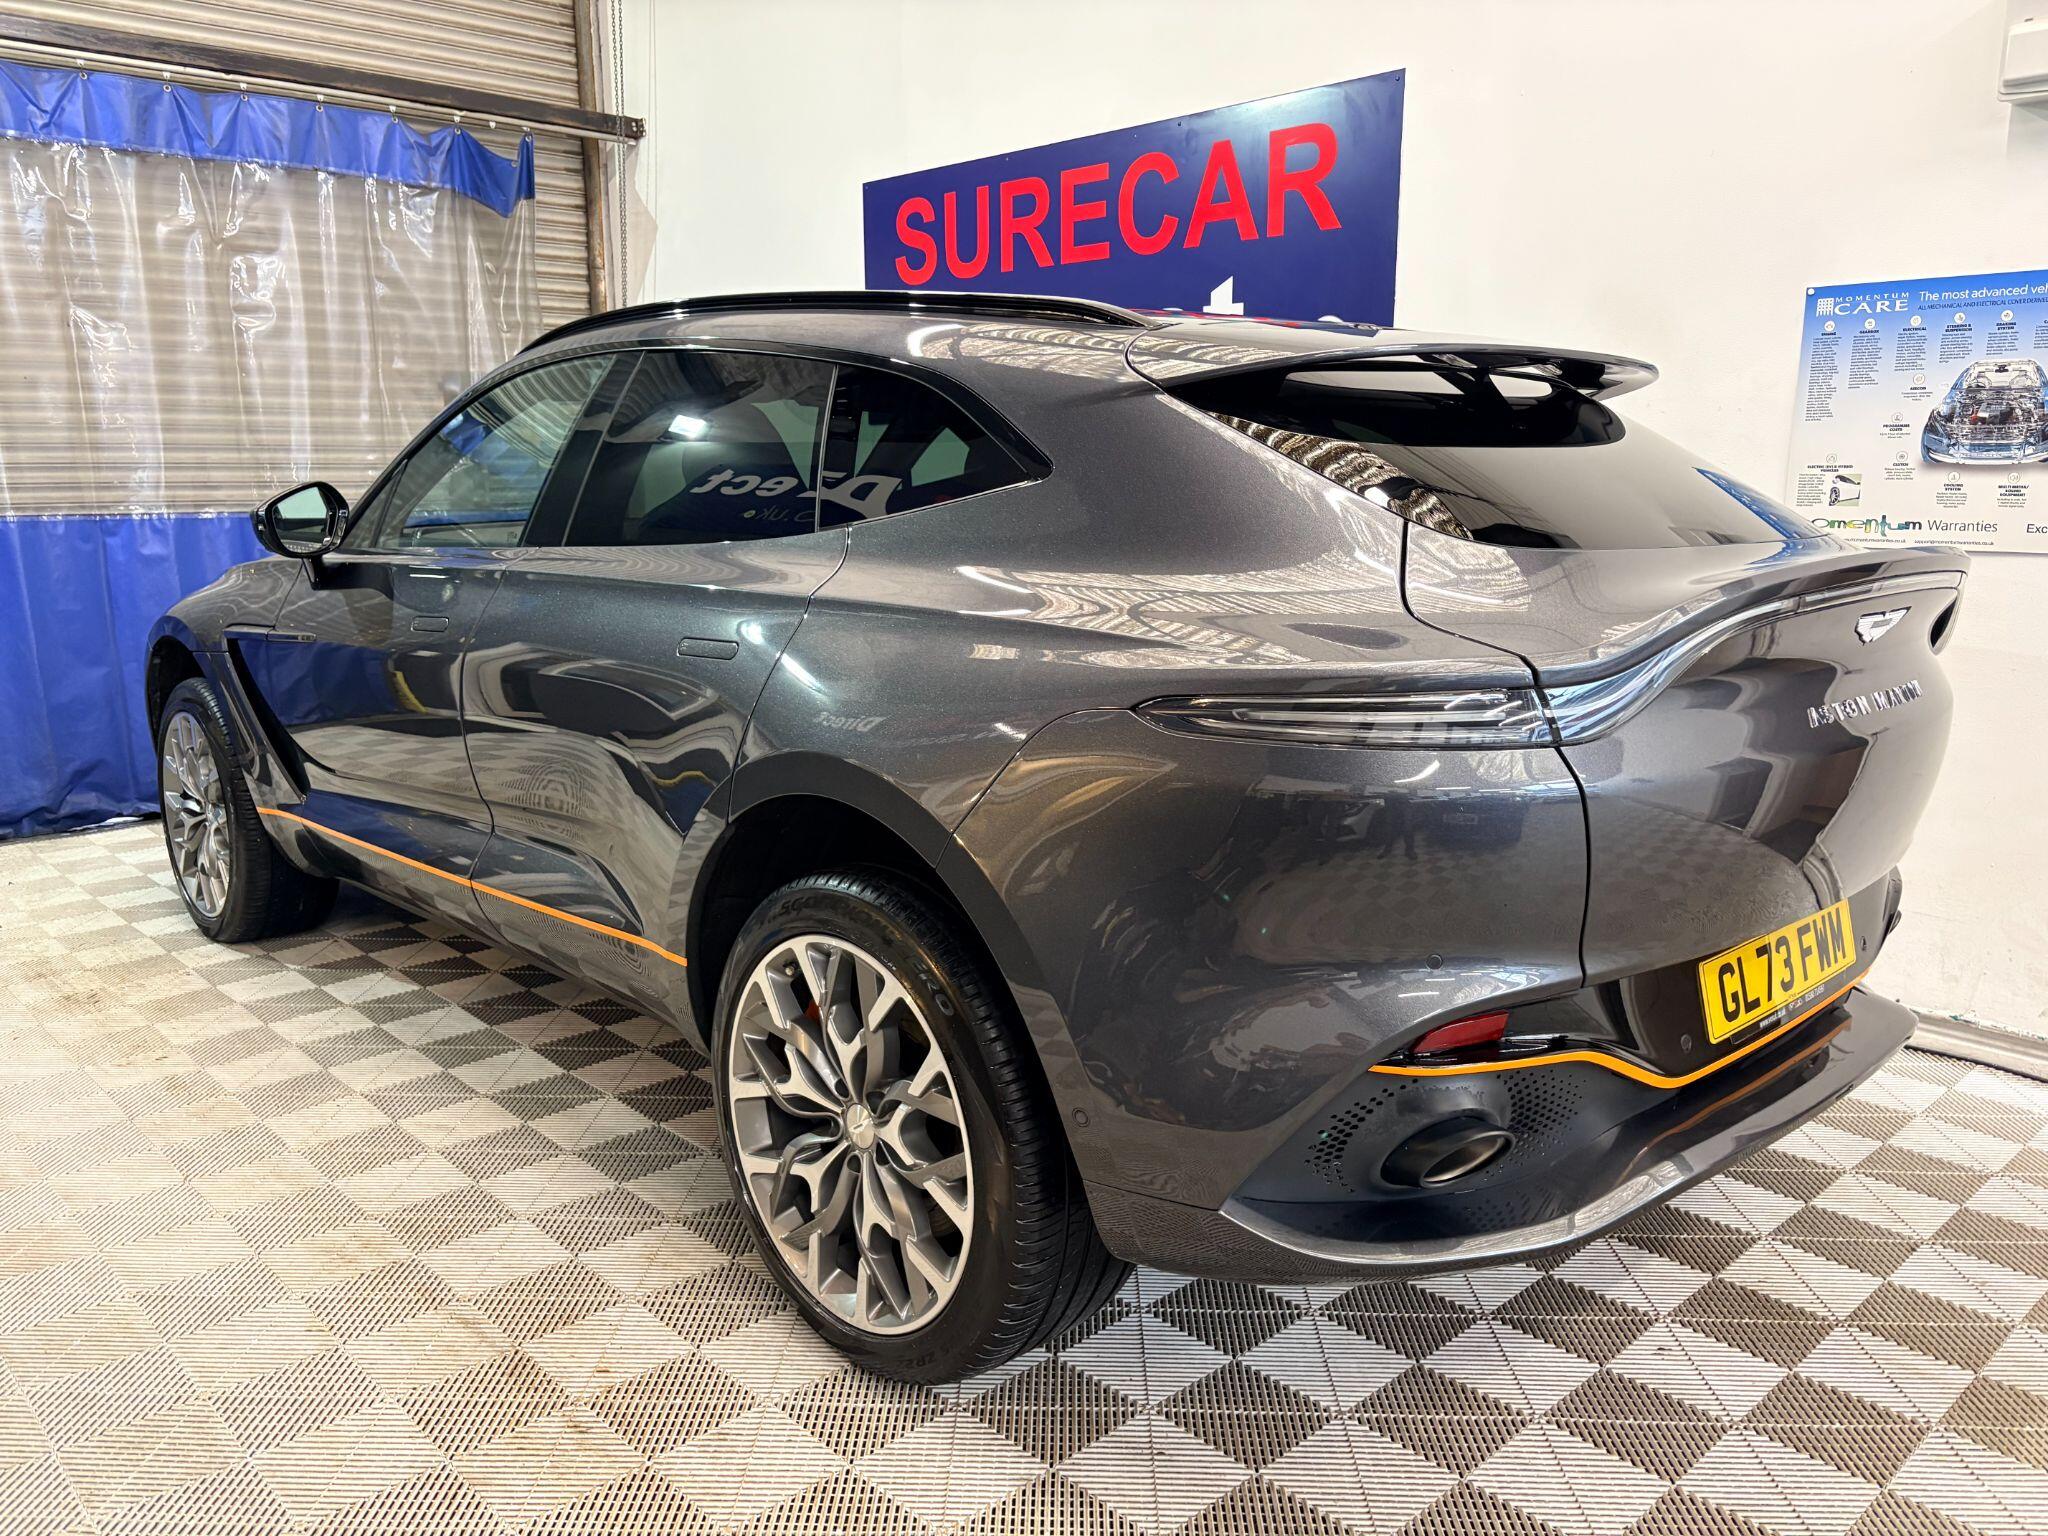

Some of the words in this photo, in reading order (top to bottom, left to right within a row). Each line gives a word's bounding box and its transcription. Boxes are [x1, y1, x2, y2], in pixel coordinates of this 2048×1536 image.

[895, 121, 1342, 287] SURECAR
[1836, 292, 1910, 303] MOMENTUM
[1919, 291, 1940, 302] The
[1942, 289, 1970, 301] most
[1971, 284, 2028, 299] advanced
[1835, 299, 1909, 316] CARE
[1811, 515, 1922, 538] omentum
[1927, 519, 1998, 533] Warranties
[2026, 523, 2048, 534] Exc
[1807, 695, 1872, 729] ASTON
[1717, 934, 1795, 1024] GL73
[1796, 907, 1847, 982] FWM
